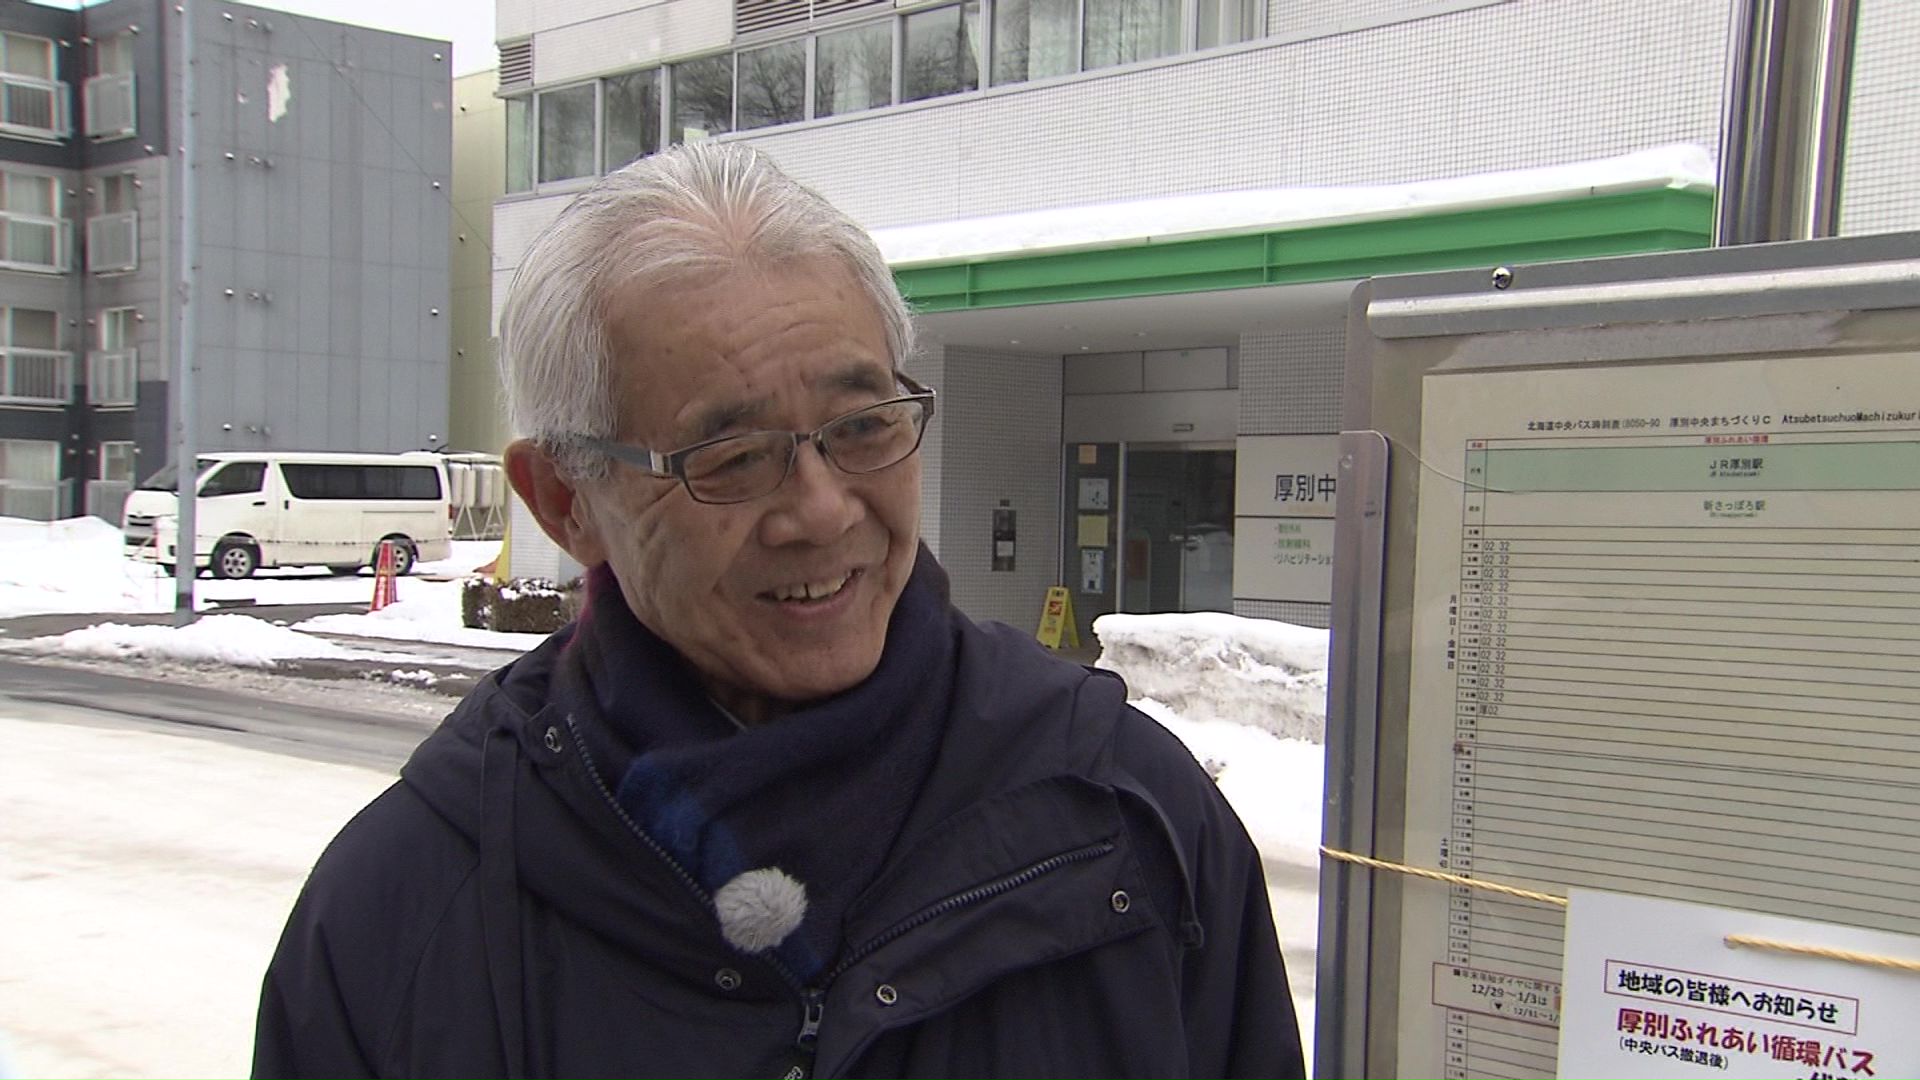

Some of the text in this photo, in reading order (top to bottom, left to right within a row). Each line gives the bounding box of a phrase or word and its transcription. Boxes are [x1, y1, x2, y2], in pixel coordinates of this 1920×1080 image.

[1781, 412, 1920, 424] AtsubetsuchuoMachizukur
[1274, 473, 1337, 502] 厚別中
[1617, 969, 1839, 1024] 地域の皆様へお知らせ
[1616, 1007, 1876, 1077] 厚別ふれあい循環バス
[1619, 1036, 1729, 1070] (中央バス撤退後)
